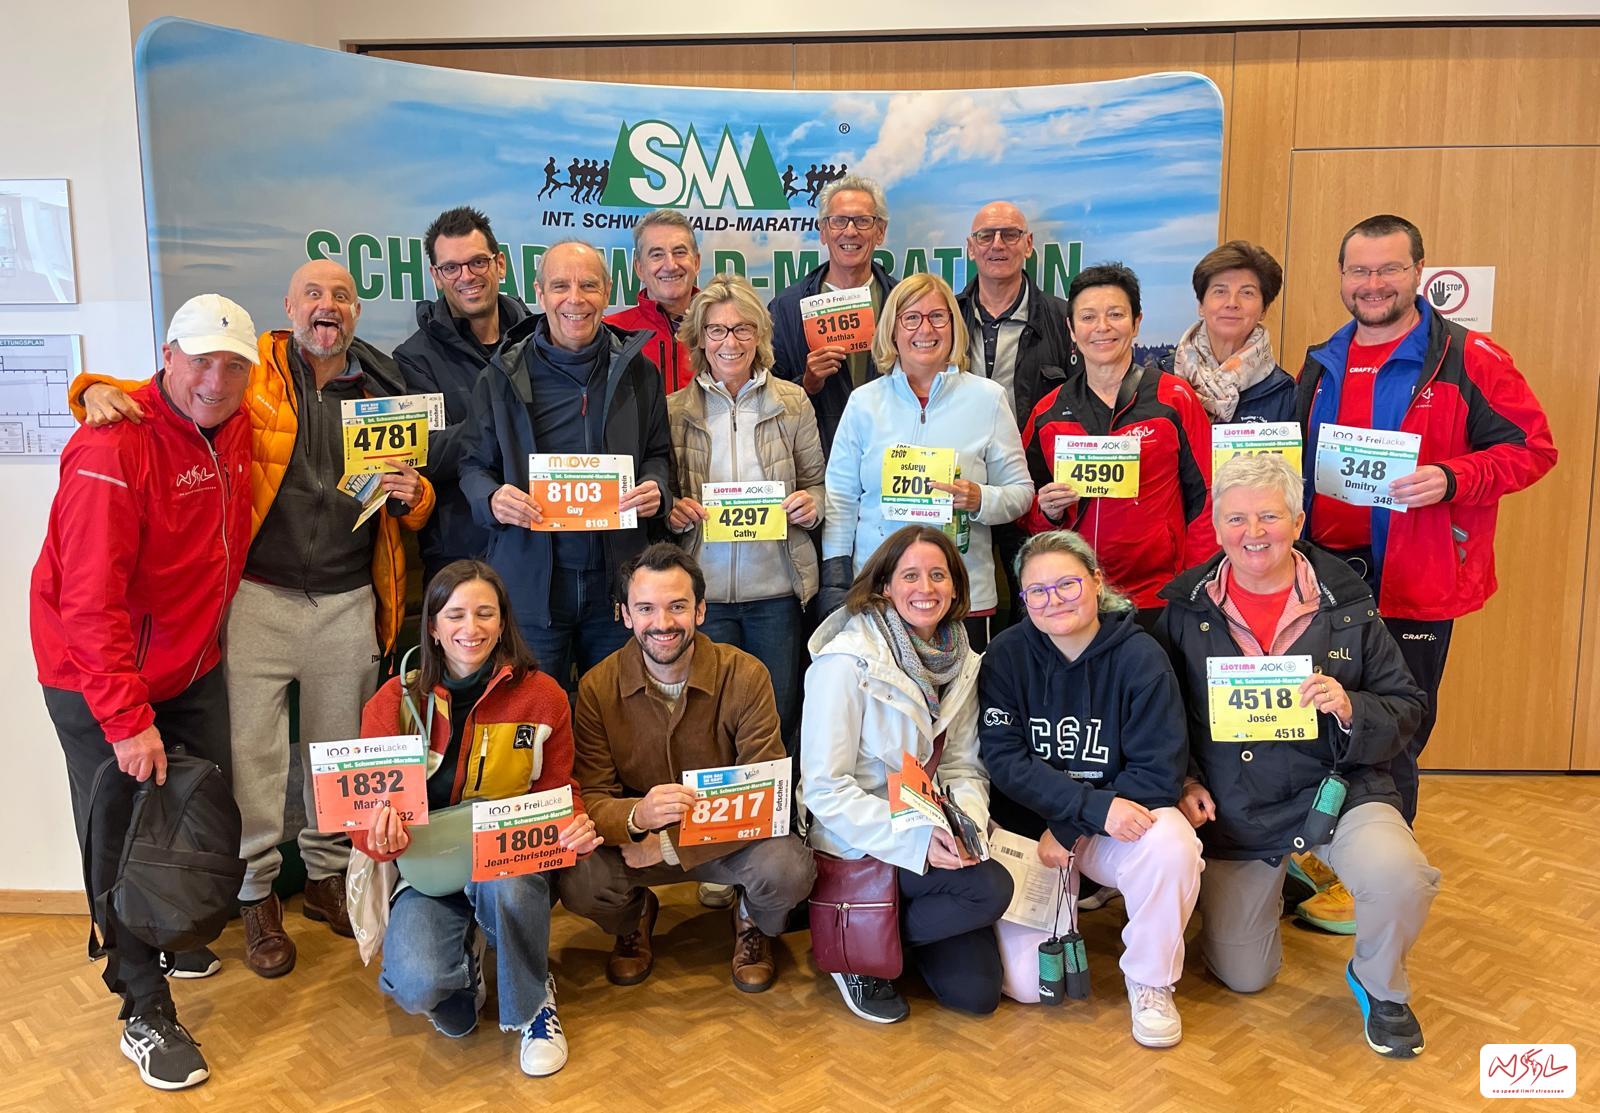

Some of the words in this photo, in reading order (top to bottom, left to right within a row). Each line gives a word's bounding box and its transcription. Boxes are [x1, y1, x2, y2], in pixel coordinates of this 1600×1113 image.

[628, 121, 755, 208] SM
[542, 211, 575, 227] INT.
[582, 213, 821, 233] SCHWALD-MARATH
[1446, 283, 1462, 291] STOP
[817, 313, 861, 335] 3165
[826, 333, 855, 344] Mathias
[850, 341, 868, 351] 3165
[353, 422, 418, 452] 4781
[1259, 428, 1279, 436] AOK
[1101, 442, 1120, 450] AOK
[891, 450, 907, 459] 4042
[401, 458, 419, 469] 781
[901, 463, 926, 473] Maryse
[1340, 456, 1388, 481] 348
[1070, 463, 1125, 483] 4590
[745, 486, 765, 495] AOK
[892, 476, 937, 495] 4042
[1085, 485, 1109, 495] Netty
[1344, 480, 1378, 494] Dmitry
[546, 482, 603, 503] 8103
[1373, 496, 1394, 506] 348
[567, 506, 584, 517] Guy
[719, 507, 770, 527] 4297
[894, 507, 908, 516] AOK
[585, 519, 609, 528] 8103
[733, 529, 758, 539] Cathy
[1402, 633, 1428, 641] CRAFT
[1260, 662, 1284, 672] AOK
[1228, 687, 1293, 710] 4518
[1247, 713, 1278, 724] Josée
[1029, 716, 1109, 764] CSL
[1274, 727, 1305, 740] 4518
[336, 769, 405, 798] 1832
[775, 779, 784, 812] Gutschein
[691, 791, 767, 825] 8217
[396, 811, 414, 823] 32
[495, 824, 559, 854] 1809
[737, 827, 761, 840] 8217
[484, 846, 568, 869] Jean-Christophe
[537, 857, 563, 870] 1809
